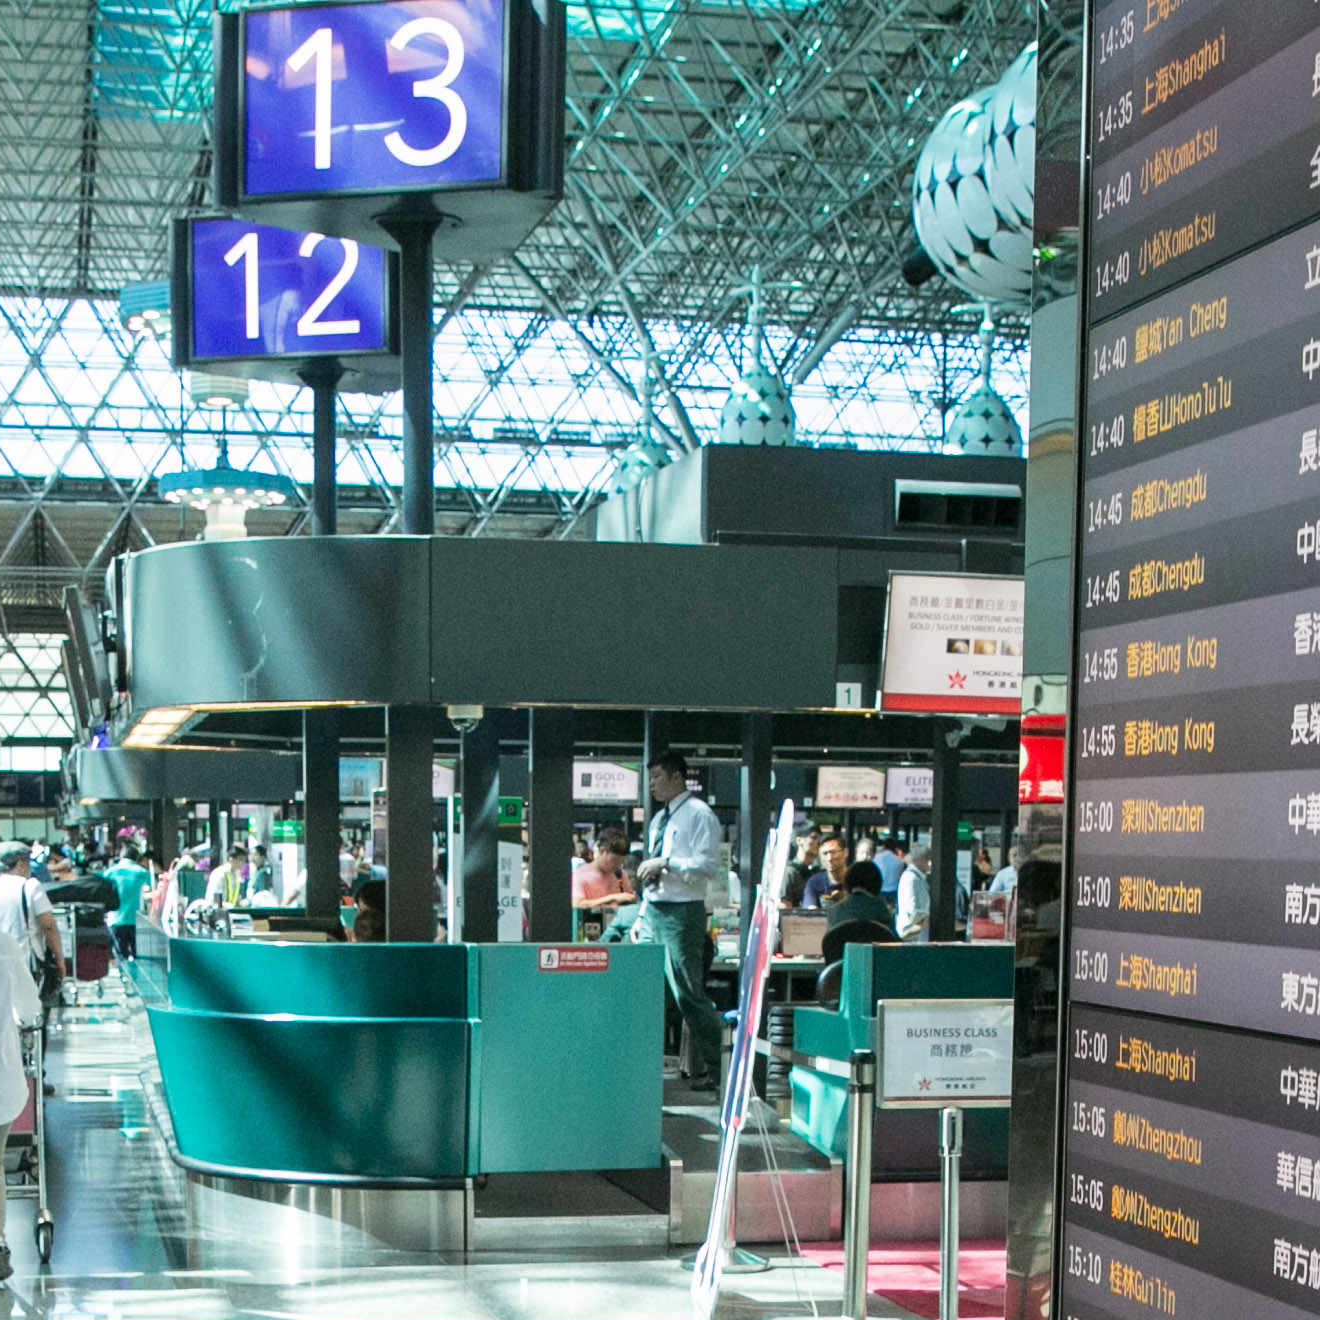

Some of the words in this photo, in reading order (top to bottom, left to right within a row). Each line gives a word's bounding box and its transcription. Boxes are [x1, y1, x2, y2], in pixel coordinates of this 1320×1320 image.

[1100, 9, 1135, 64] 14:35
[284, 14, 470, 171] 13
[1098, 90, 1133, 143] 14:35
[1140, 33, 1226, 115] 上海Shanghai
[1096, 171, 1132, 220] 14:40
[221, 229, 361, 340] 12
[1095, 250, 1130, 298] 14:40
[1092, 335, 1127, 380] 14:40
[1090, 414, 1125, 457] 14:40
[1088, 491, 1123, 533] 14:45
[1130, 469, 1207, 521] 成都Chengdu
[1085, 569, 1121, 608] 14:45
[1128, 552, 1205, 600] 成都Chengdu
[909, 622, 931, 632] GOLD
[1083, 647, 1119, 683] 14:55
[843, 686, 853, 705] 1
[1081, 724, 1116, 758] 14:55
[594, 771, 626, 783] GOLD
[1079, 800, 1114, 833] 15:00
[1120, 798, 1205, 834] 深圳Shenzhen
[1076, 875, 1112, 908] 15:00
[1118, 875, 1202, 914] 深圳Shenzhen
[1074, 949, 1109, 984] 15:00
[1115, 953, 1198, 997] 上海Shanghai
[906, 1027, 962, 1039] BUSINESS
[963, 1027, 999, 1038] CLASS
[1074, 1028, 1108, 1064] 15:00
[1115, 1035, 1196, 1082] 上海Shanghai
[1072, 1101, 1106, 1138] 15:05
[1070, 1173, 1104, 1212] 15:05
[1068, 1244, 1102, 1285] 15:10
[1108, 1259, 1176, 1316] 桂林Guilin
